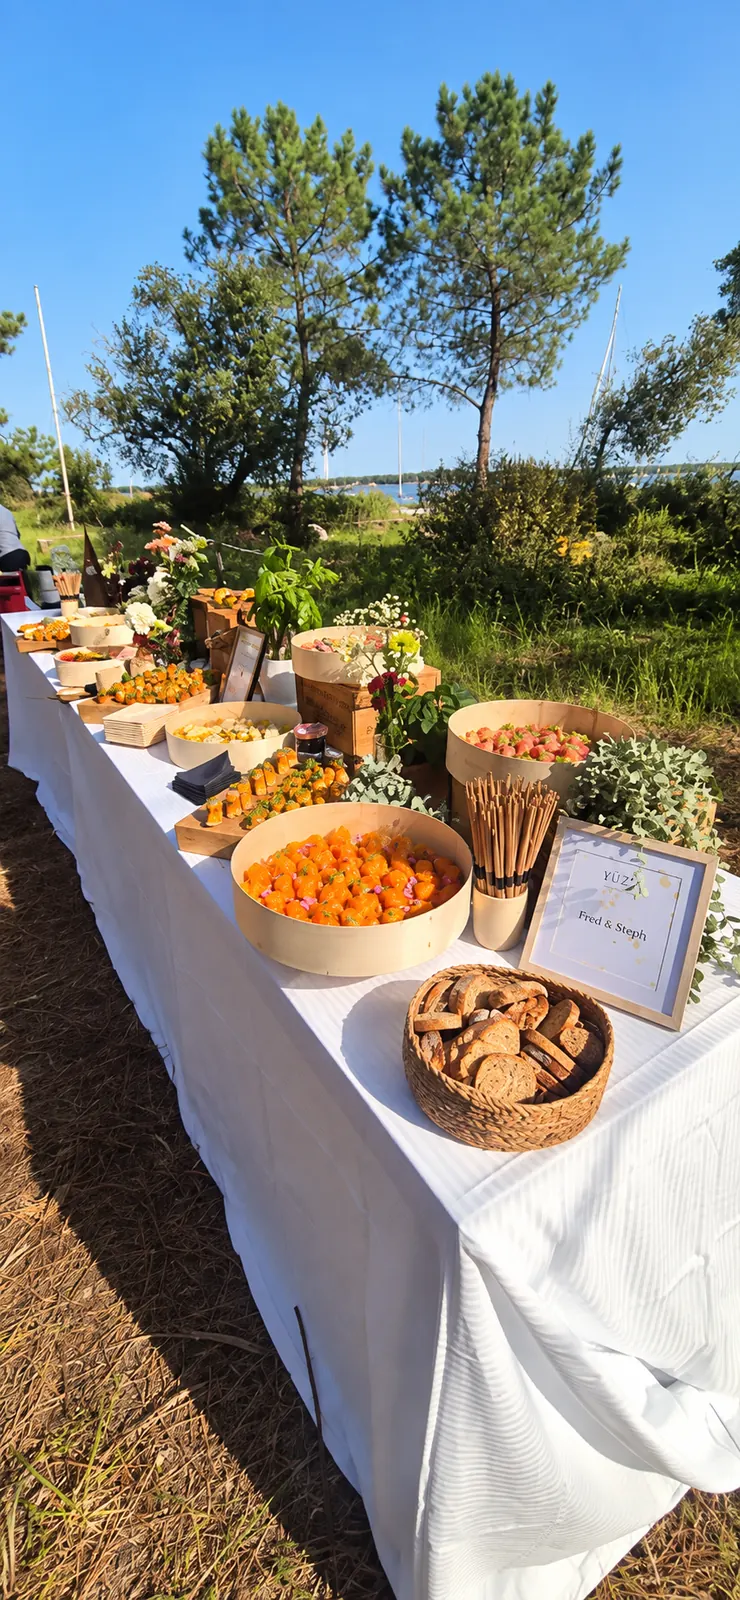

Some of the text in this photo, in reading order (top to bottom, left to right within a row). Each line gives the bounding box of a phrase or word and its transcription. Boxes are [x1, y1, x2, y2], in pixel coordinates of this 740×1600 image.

[578, 910, 647, 942] Fred & Steph
